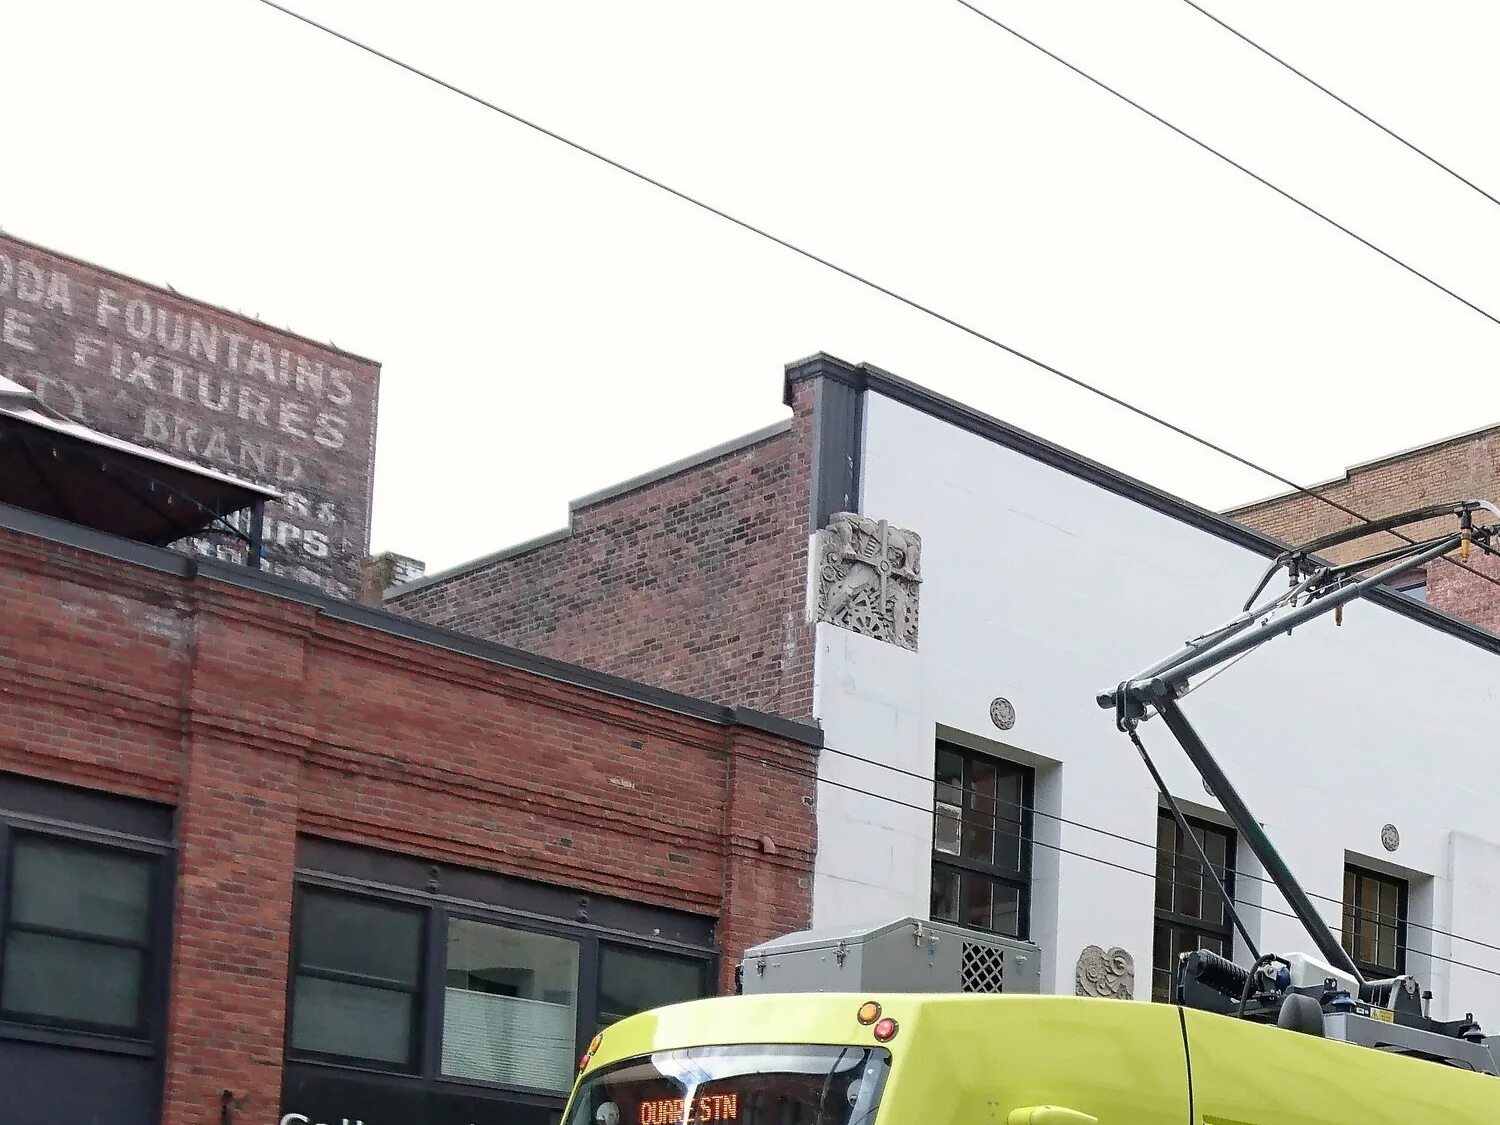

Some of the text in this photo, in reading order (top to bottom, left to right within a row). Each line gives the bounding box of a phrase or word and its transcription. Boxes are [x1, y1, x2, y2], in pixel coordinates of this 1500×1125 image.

[73, 332, 349, 449] FIXTURES
[97, 288, 353, 404] FOUNTAINS
[143, 407, 301, 481] BRAND
[699, 1094, 737, 1121] STN
